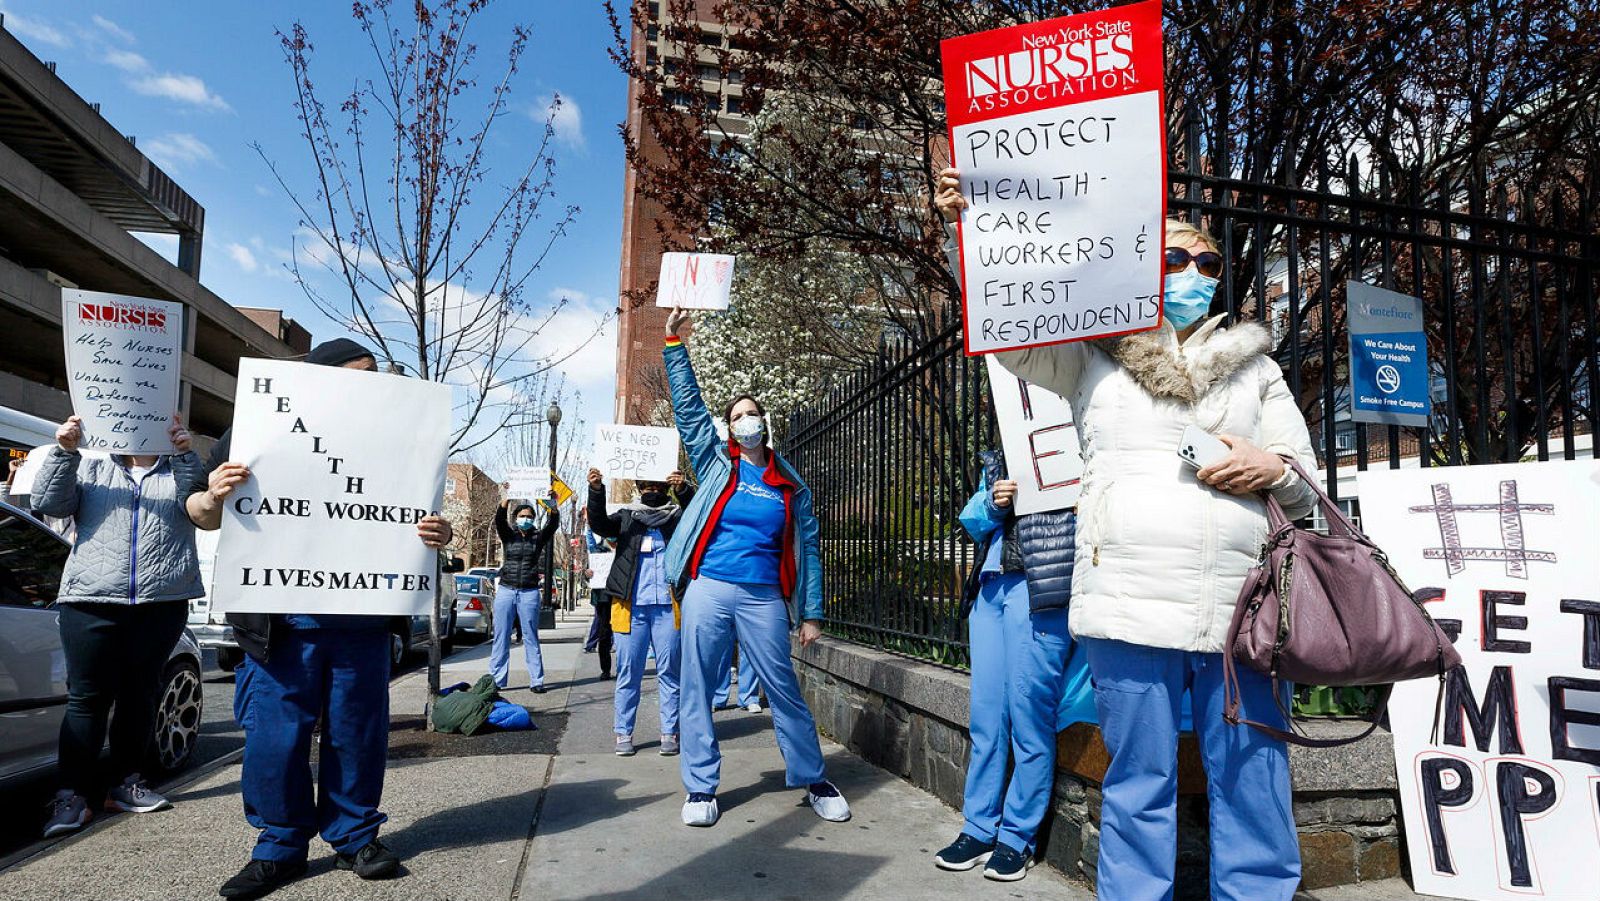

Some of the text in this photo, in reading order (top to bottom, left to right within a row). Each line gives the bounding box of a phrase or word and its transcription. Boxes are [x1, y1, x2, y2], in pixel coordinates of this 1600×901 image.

[1022, 20, 1132, 51] New York State
[965, 33, 1134, 99] NURSES
[968, 70, 1139, 114] ASSOCIATION
[966, 117, 1117, 168] PROTECT
[975, 211, 1052, 234] CARE
[979, 224, 1148, 267] WORKERS &
[984, 279, 1077, 307] FIRST
[79, 303, 166, 328] NURSES
[982, 295, 1162, 343] RESPONDENTS
[1360, 302, 1414, 320] Montefiore
[78, 319, 168, 335] ASSOCIATION
[75, 333, 113, 349] Help
[1364, 339, 1416, 352] We Care About
[1371, 351, 1411, 363] Your Health
[74, 371, 123, 385] Unleash
[86, 386, 147, 404] Defense
[1360, 395, 1424, 409] Smoke Free Campus
[97, 403, 169, 422] Production
[111, 420, 139, 433] Act
[600, 430, 661, 446] WE NEED
[614, 446, 657, 465] BETTER
[606, 458, 648, 478] PPE
[234, 496, 312, 517] CARE
[1416, 753, 1600, 893] PP
